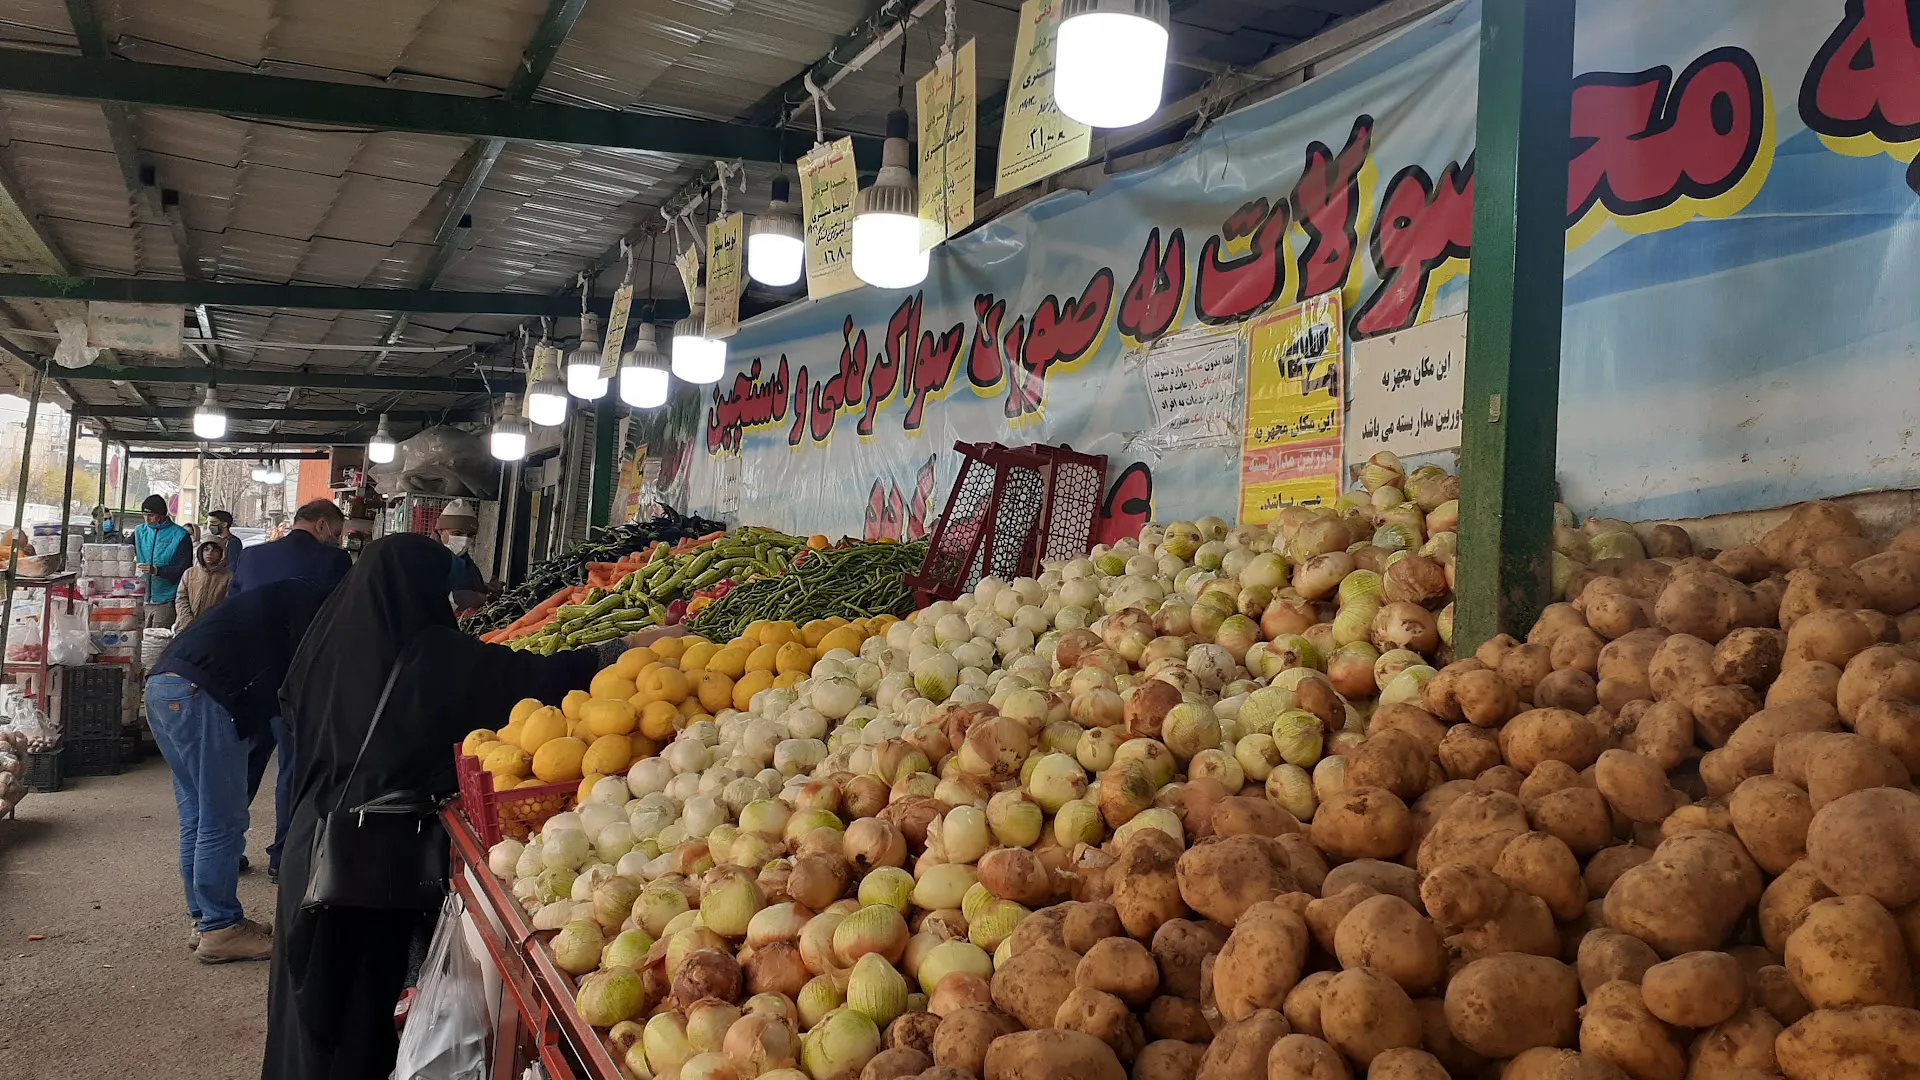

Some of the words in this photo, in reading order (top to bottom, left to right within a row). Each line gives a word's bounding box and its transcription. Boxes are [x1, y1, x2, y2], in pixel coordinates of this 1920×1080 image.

[812, 207, 832, 223] مشتری
[832, 198, 850, 213] توسط
[967, 266, 1115, 419] صورت
[1171, 365, 1184, 377] وارد
[1413, 355, 1434, 387] مکان
[1436, 350, 1451, 381] این
[1382, 371, 1390, 392] به
[1391, 368, 1412, 392] مجهز
[707, 353, 789, 457] دستچین
[789, 365, 808, 446] و
[1162, 398, 1177, 412] افراد
[1291, 414, 1315, 438] مکان
[1318, 409, 1335, 432] این
[1362, 417, 1380, 442] باشد
[1381, 421, 1395, 442] می
[1396, 415, 1414, 436] بسته
[1415, 407, 1434, 437] مدار
[1254, 427, 1263, 443] به
[1264, 424, 1288, 443] مجهز
[1248, 456, 1270, 475] بسته
[1272, 454, 1295, 477] مدار
[1297, 447, 1334, 471] دوربین
